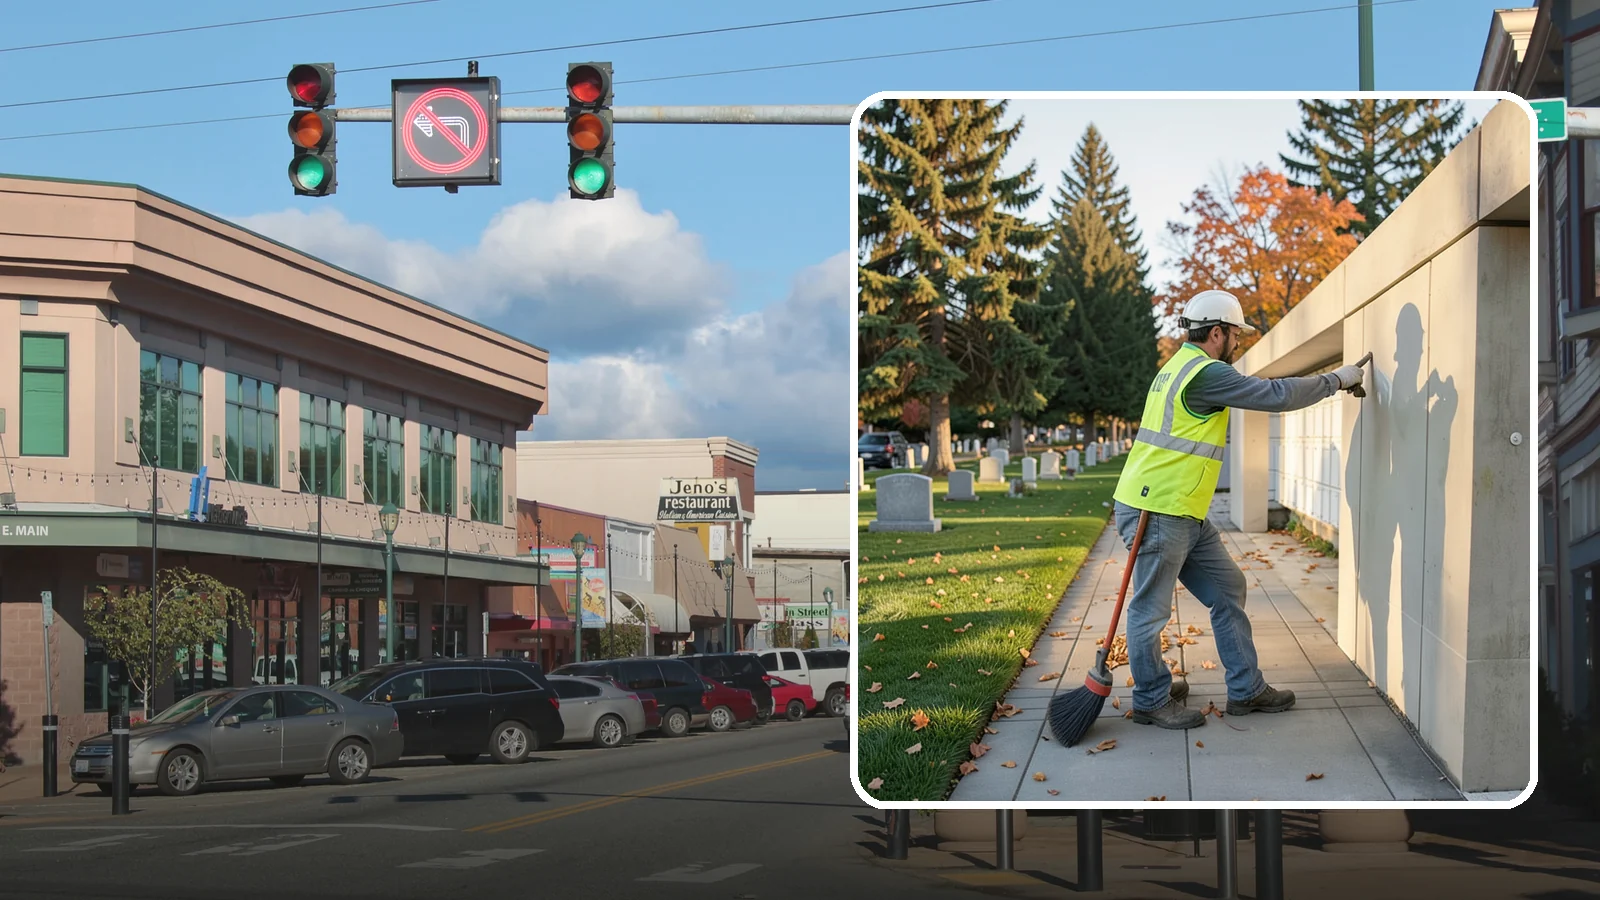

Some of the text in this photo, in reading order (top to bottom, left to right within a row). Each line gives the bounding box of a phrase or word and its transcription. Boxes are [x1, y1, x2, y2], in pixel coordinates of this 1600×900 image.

[670, 480, 727, 494] Jeno's
[665, 496, 730, 509] restaurant
[659, 510, 681, 519] Italian
[686, 510, 714, 519] American
[715, 510, 737, 519] Cuisine
[2, 525, 49, 536] E. MAIN
[798, 608, 828, 616] Street
